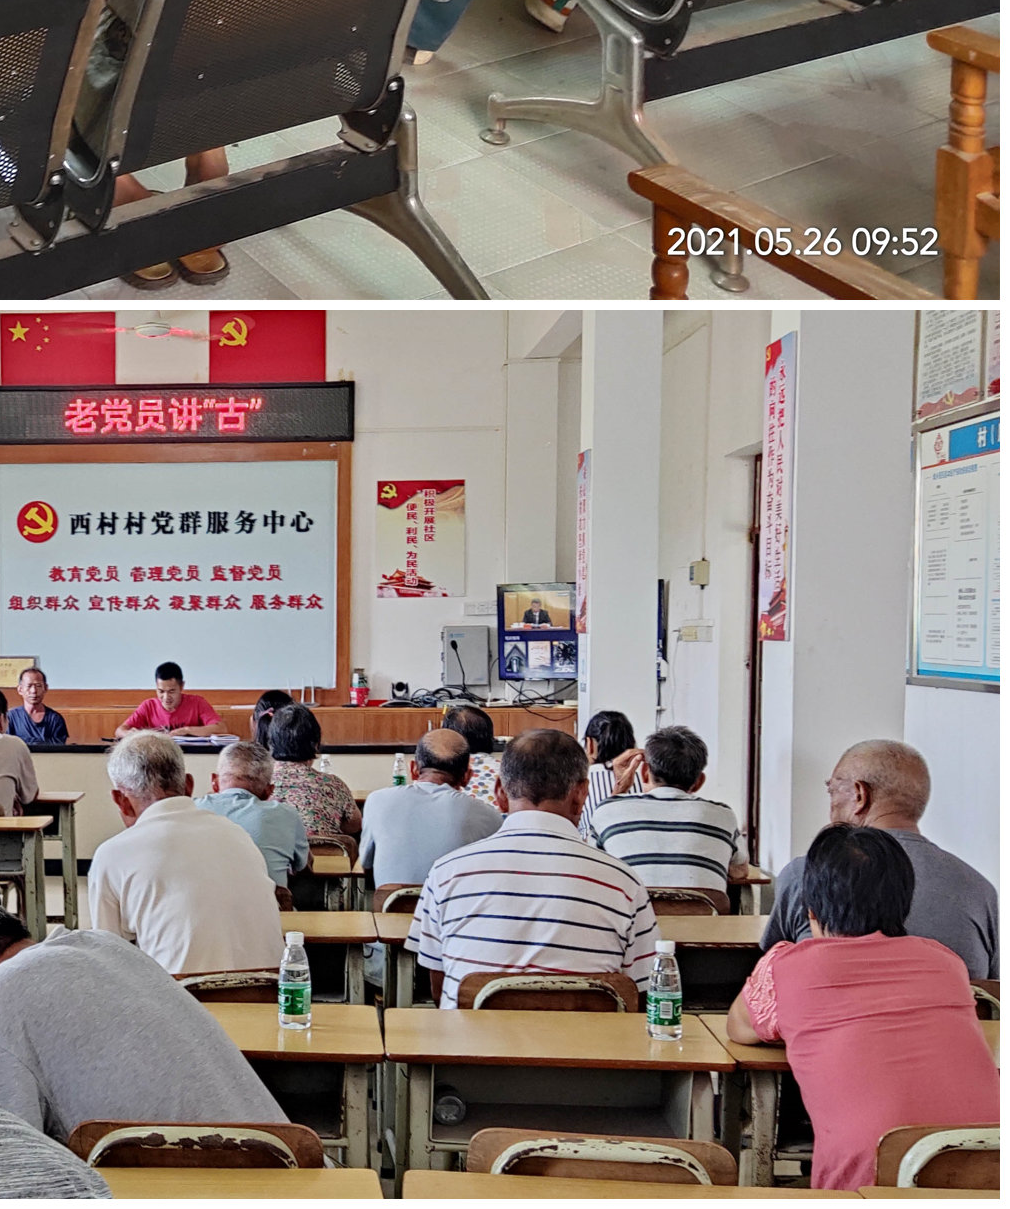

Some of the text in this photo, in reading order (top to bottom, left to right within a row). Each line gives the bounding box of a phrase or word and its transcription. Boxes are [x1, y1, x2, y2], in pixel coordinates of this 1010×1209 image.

[64, 396, 263, 434] 老党员讲“古”
[69, 510, 314, 536] 西村村党群服务中心
[423, 489, 436, 542] 积极开展社区
[405, 502, 419, 586] 便民、利民、为民活动
[48, 564, 283, 583] 教育党员 管理党员 监督党员
[8, 593, 324, 611] 组织群众 宣传群众 凝聚群众 服务群众
